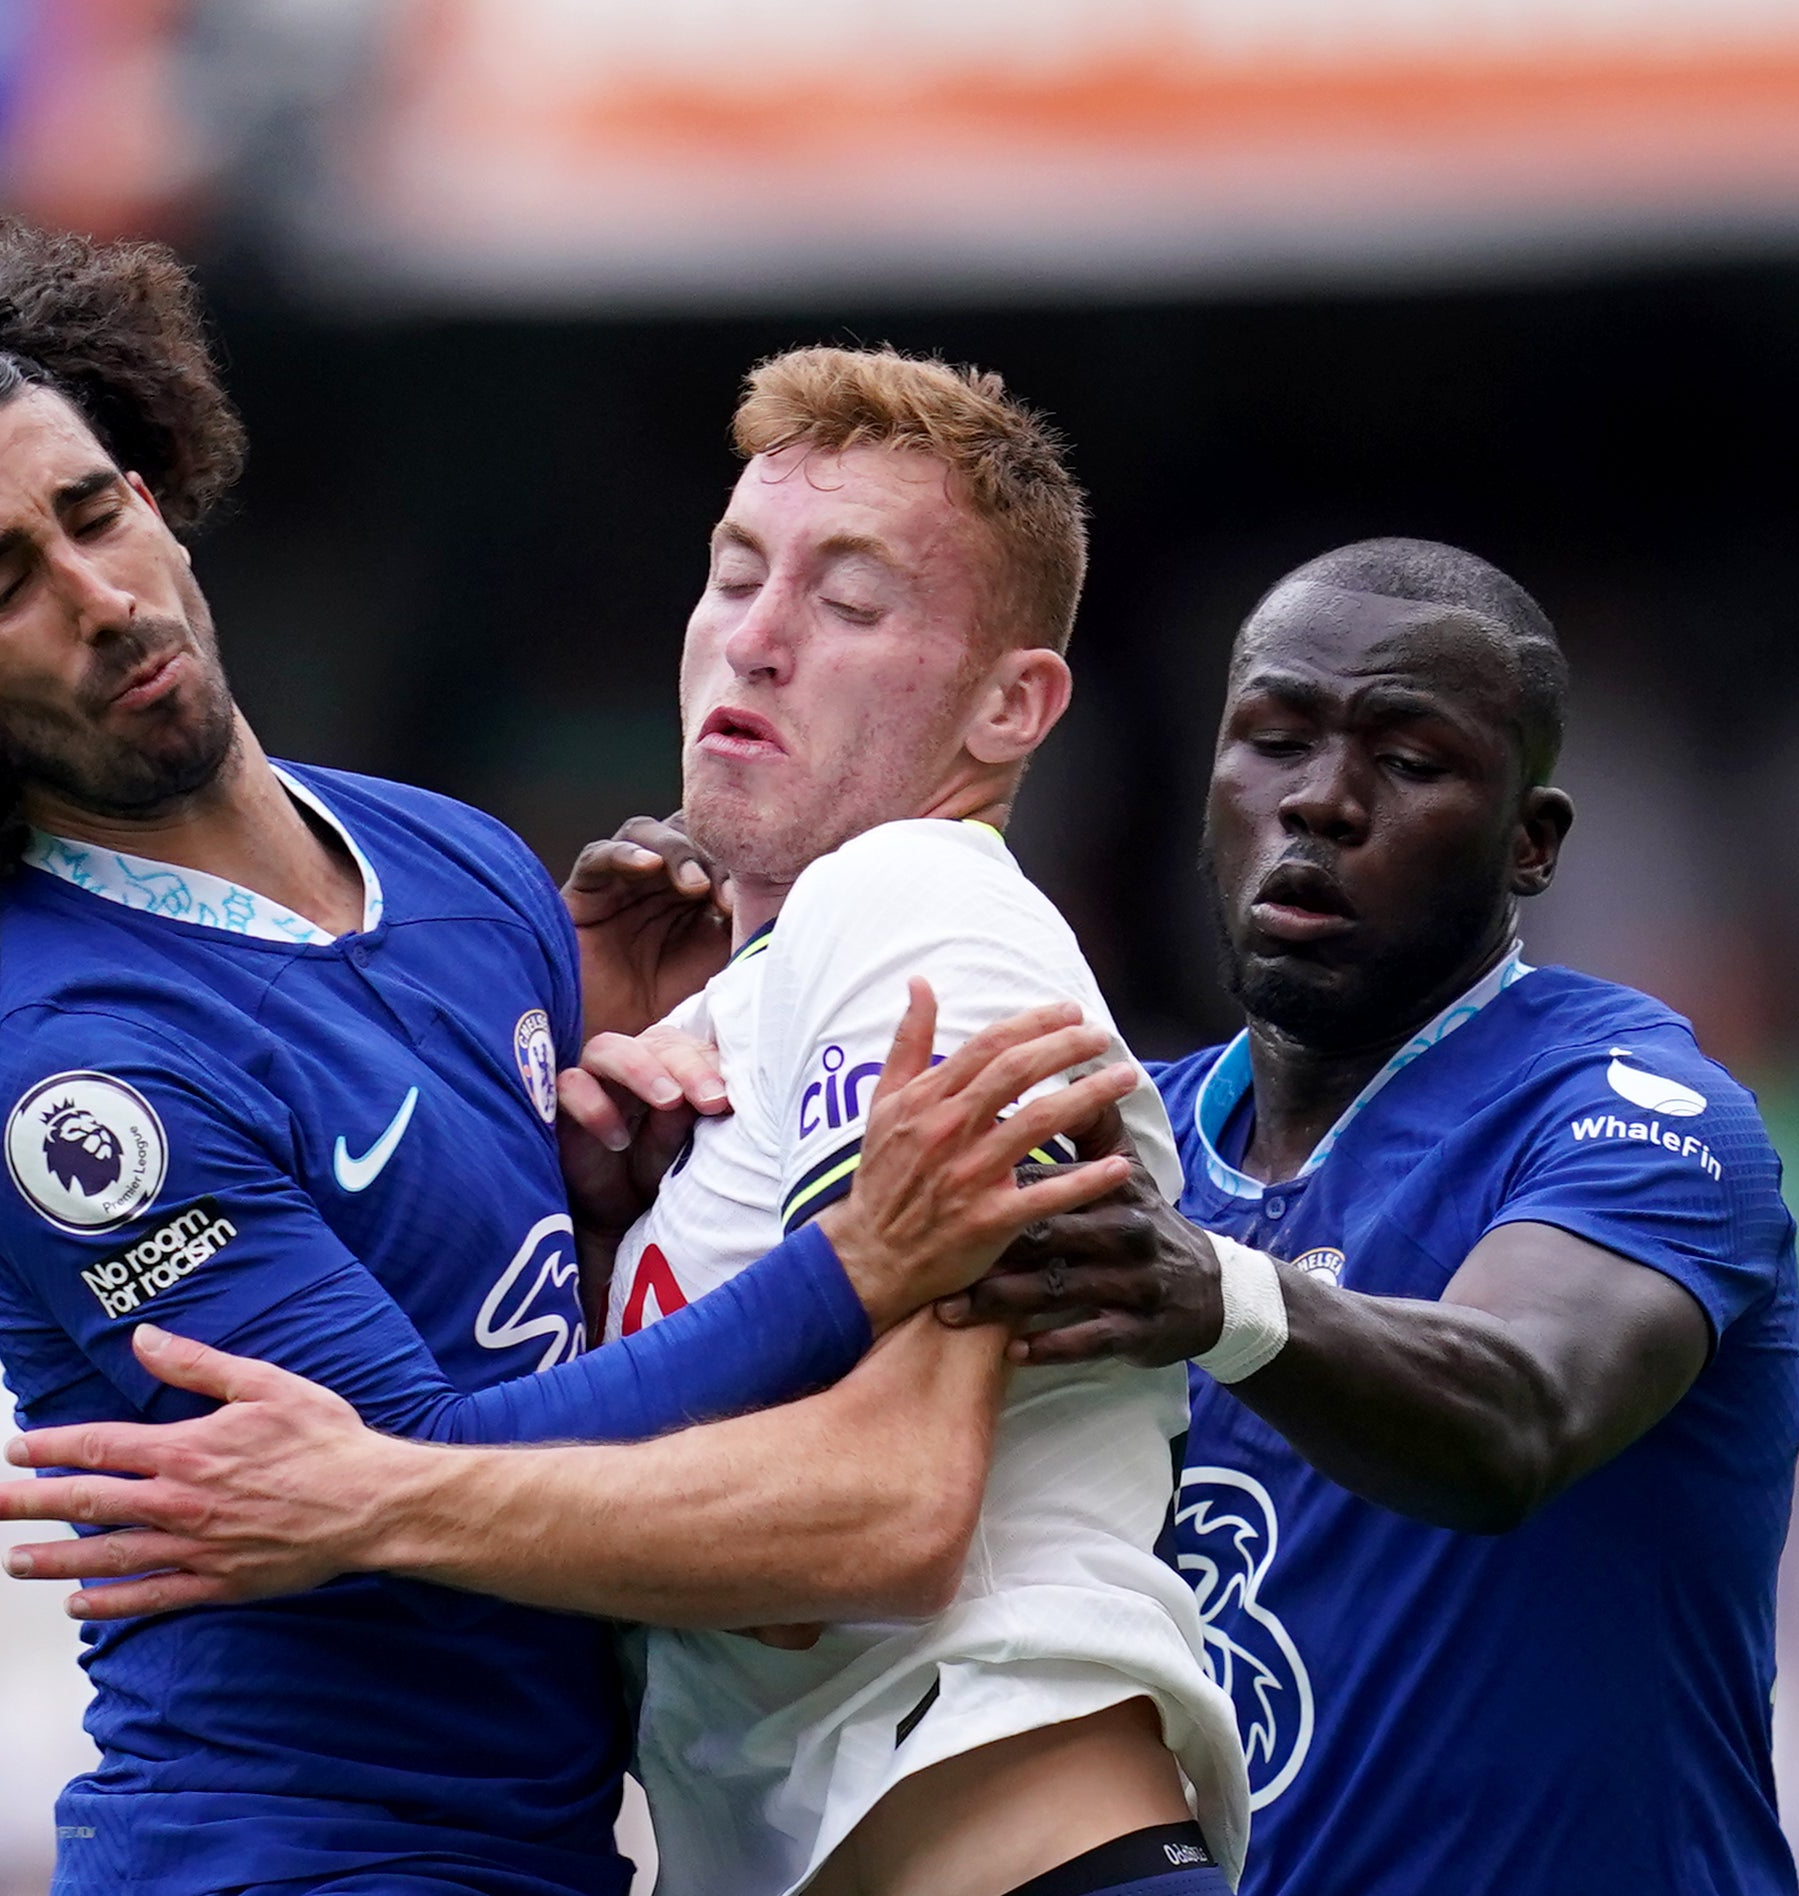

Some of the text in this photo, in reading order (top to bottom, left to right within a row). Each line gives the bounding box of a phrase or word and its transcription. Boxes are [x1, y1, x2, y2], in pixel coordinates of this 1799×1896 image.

[103, 1126, 148, 1213] Premier League
[1571, 1115, 1722, 1181] WhaleFin
[80, 1208, 210, 1296] No room
[97, 1218, 238, 1319] for racism
[1297, 1252, 1343, 1277] HELSEA
